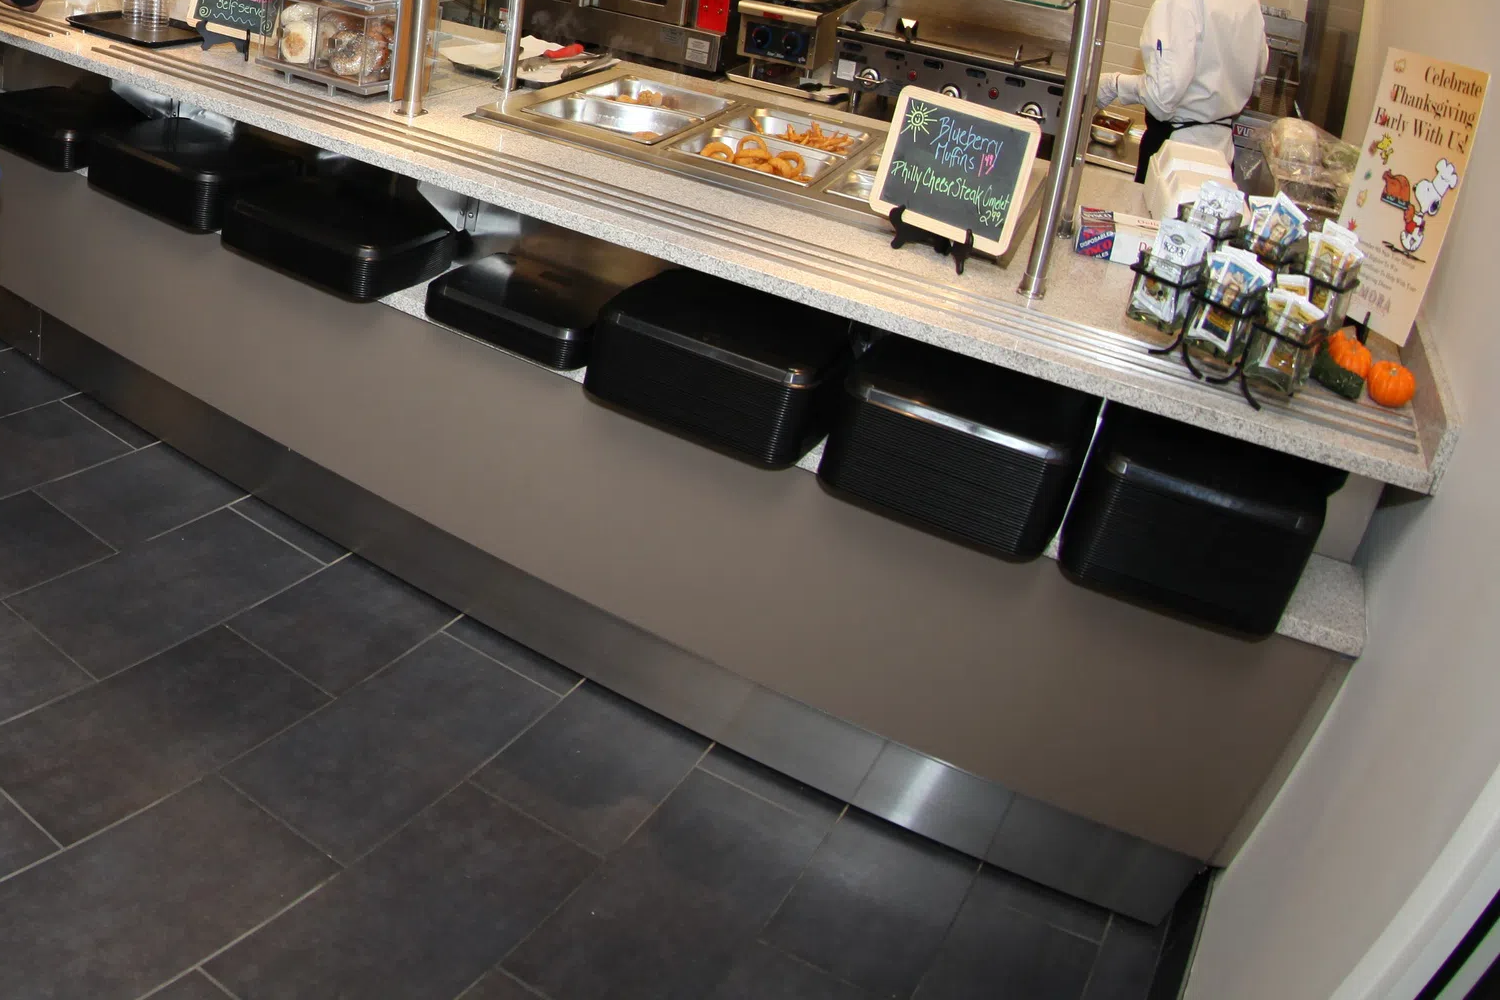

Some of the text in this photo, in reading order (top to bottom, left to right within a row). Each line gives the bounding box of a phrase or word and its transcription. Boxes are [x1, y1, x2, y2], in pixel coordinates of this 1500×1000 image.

[1424, 65, 1483, 98] Celebrate
[1391, 83, 1477, 130] Thanksgiving
[930, 116, 1003, 167] Blueberry
[1374, 106, 1469, 155] Early With Us!
[934, 141, 975, 173] Muffins
[891, 160, 923, 193] Philly
[952, 178, 985, 214] Steak
[982, 185, 1010, 211] Omelet
[1079, 230, 1115, 248] DISPOSABLES
[1359, 284, 1391, 315] MORA
